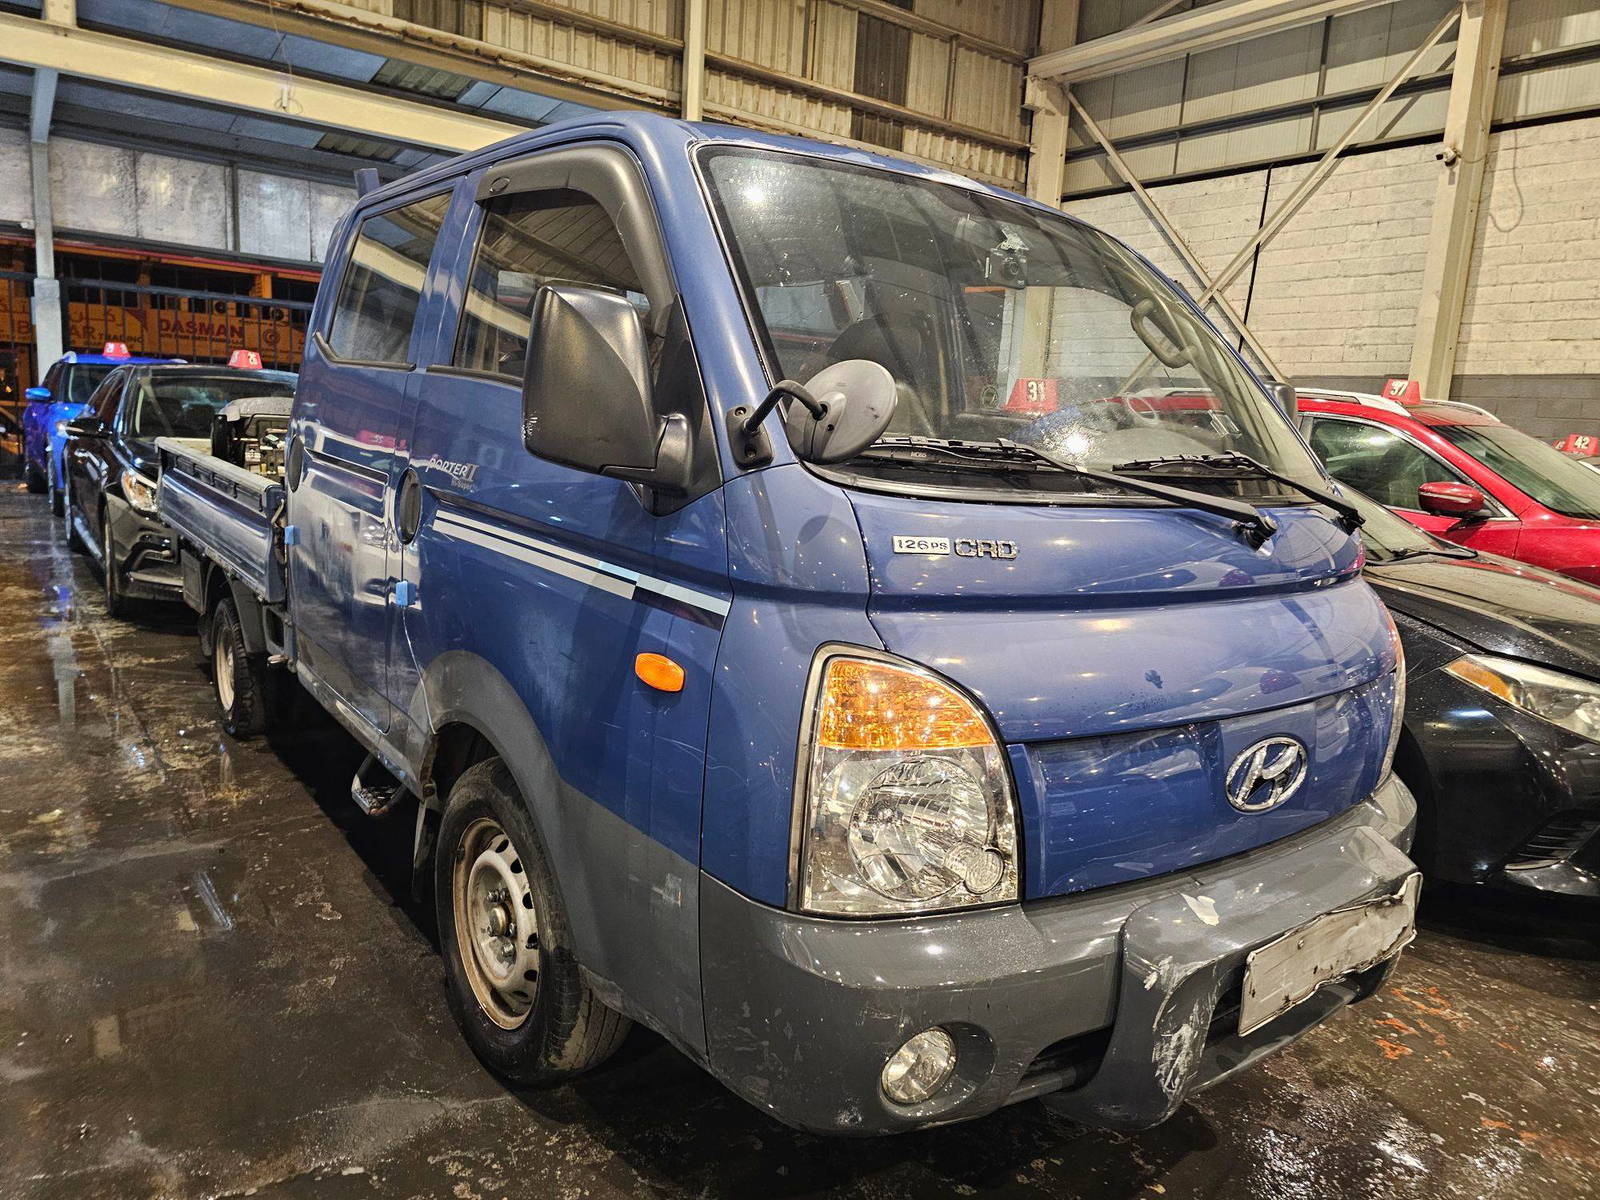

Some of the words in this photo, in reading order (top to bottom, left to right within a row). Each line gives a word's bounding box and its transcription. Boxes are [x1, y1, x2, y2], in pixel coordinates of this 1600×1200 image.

[159, 318, 244, 338] DASMAN
[1027, 380, 1047, 402] 31
[1389, 380, 1409, 397] 37
[1573, 435, 1590, 450] 42
[425, 457, 468, 478] PORTER
[897, 538, 949, 551] 126PS
[954, 537, 1019, 561] CRD
